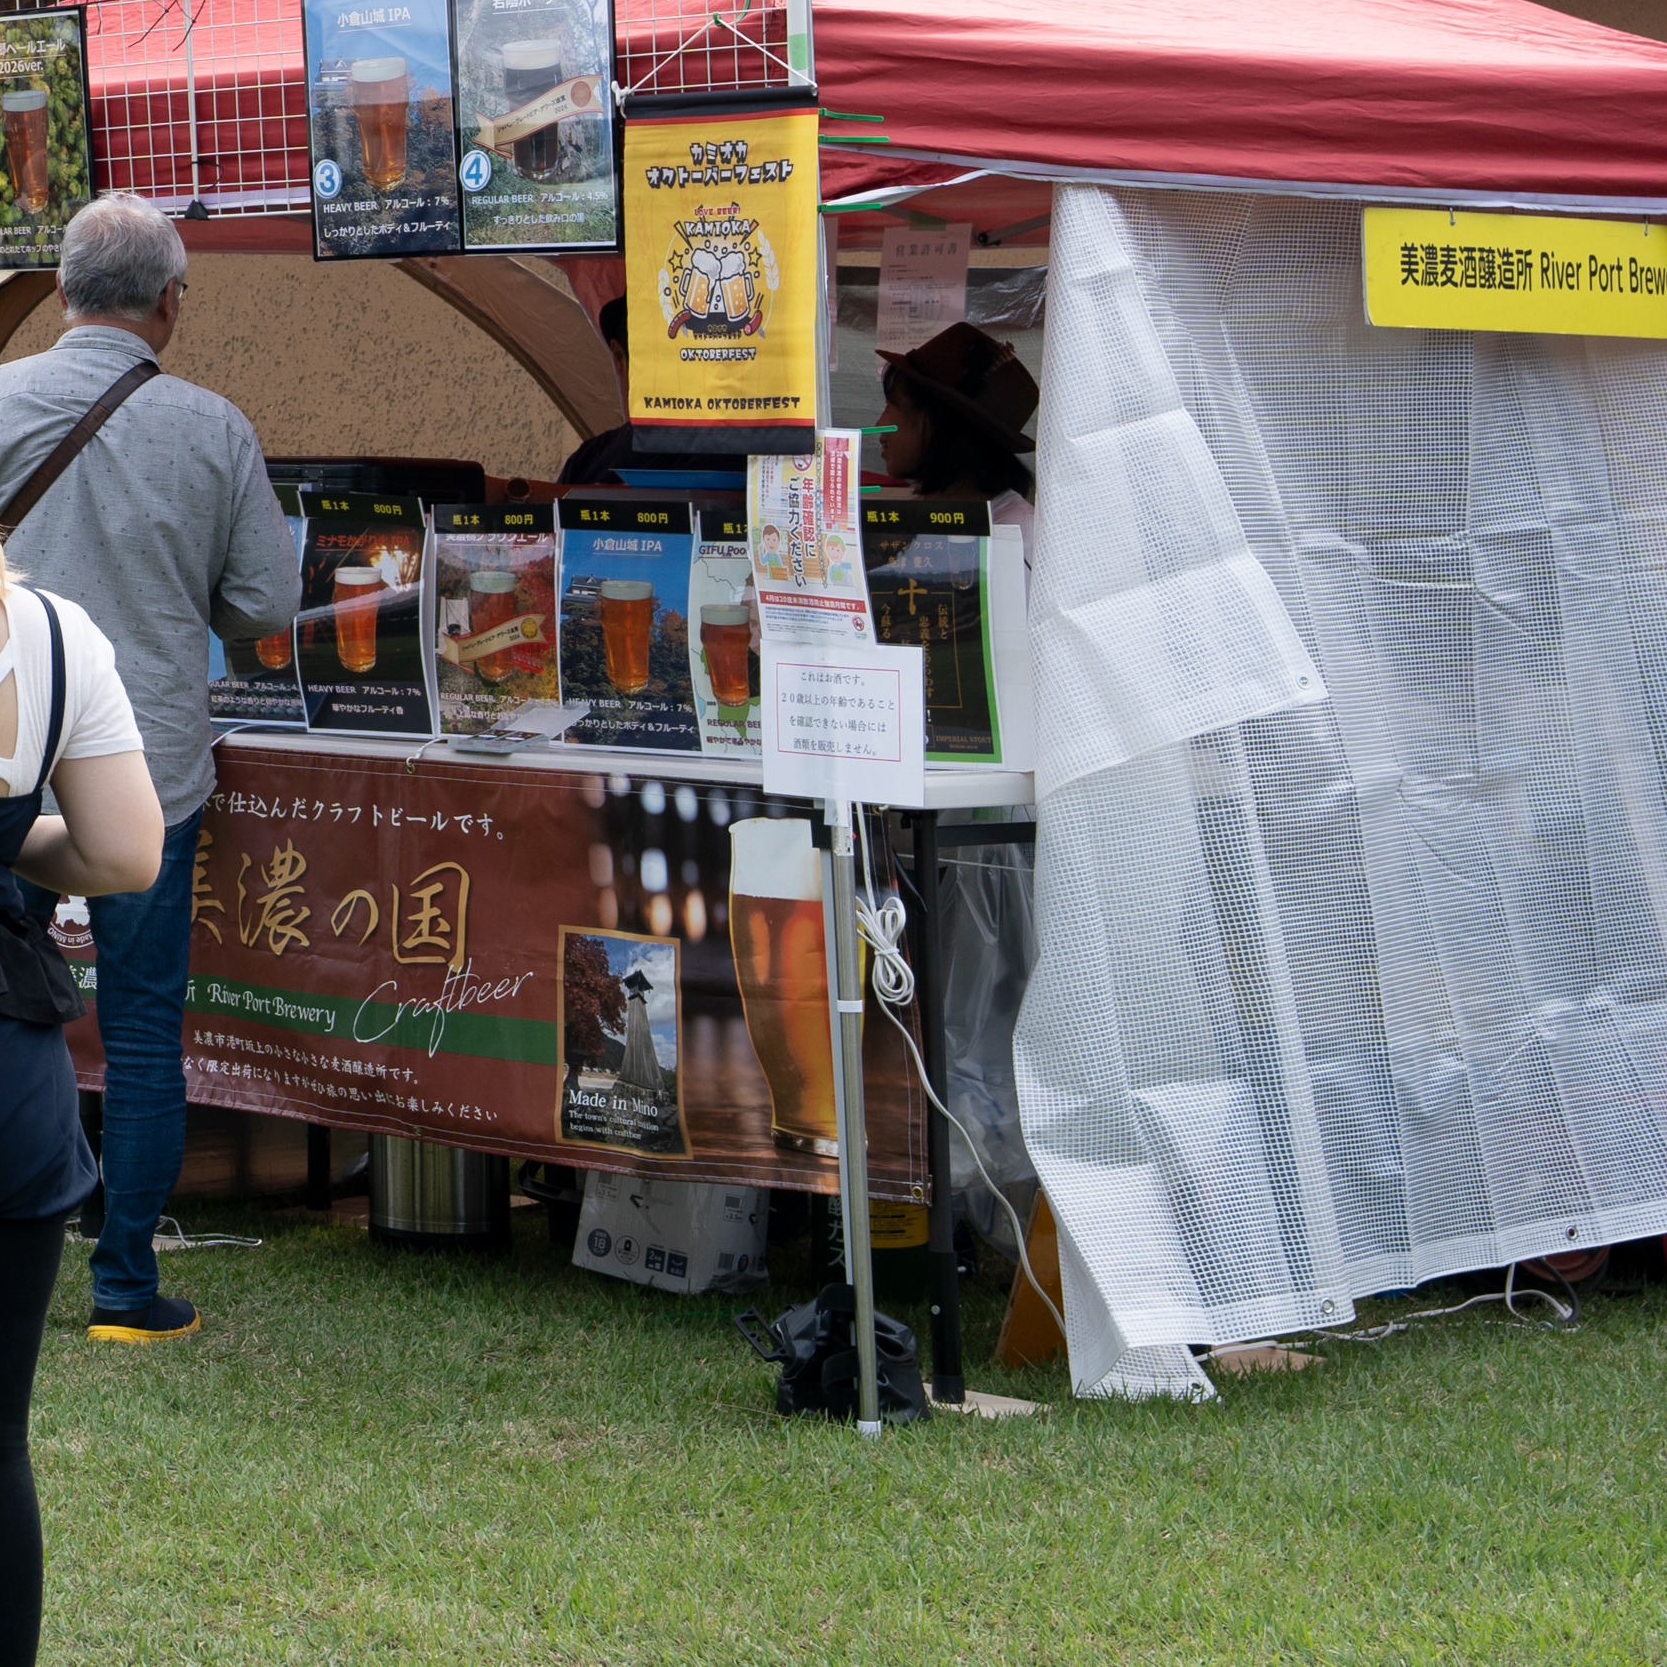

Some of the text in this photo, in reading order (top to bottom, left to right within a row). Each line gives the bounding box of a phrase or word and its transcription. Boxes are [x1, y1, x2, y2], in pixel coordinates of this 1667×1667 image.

[336, 6, 412, 30] 小倉山城 IPA
[689, 140, 748, 164] カミオカ
[319, 164, 335, 192] 3
[464, 155, 484, 186] 4
[645, 159, 794, 190] オクトーバーフェスト
[323, 199, 378, 214] HEAVY BEER
[471, 193, 534, 206] REGULAR BEER
[694, 206, 715, 216] LOVE
[13, 225, 31, 236] BEER
[683, 218, 753, 237] KAMIOKA
[1399, 242, 1667, 296] 美濃麦酒醸造所 River Port Brew
[679, 347, 757, 362] OKTOBERFEST
[643, 396, 801, 411] KAMIOKA OKTOBERFEST
[373, 503, 402, 516] 800円
[580, 509, 669, 524] 瓶1本 800円
[504, 514, 534, 526] 800円
[802, 476, 817, 559] 年齢確認に
[929, 512, 965, 524] 900円
[787, 476, 807, 588] ご協力ください
[593, 538, 663, 552] 小倉山城 IPA
[698, 545, 724, 556] GIFU
[801, 671, 866, 687] これはお酒です。
[308, 684, 357, 694] HEAVY BEER
[440, 692, 494, 703] REGULAR BEER
[598, 699, 621, 709] BEER
[789, 715, 887, 733] を確認できない場合には
[793, 737, 877, 756] 酒類を販売しません。
[207, 982, 241, 1005] River
[242, 993, 271, 1015] Port
[272, 995, 336, 1033] Brewery
[569, 1089, 658, 1117] Made in Mino
[569, 1110, 583, 1119] The
